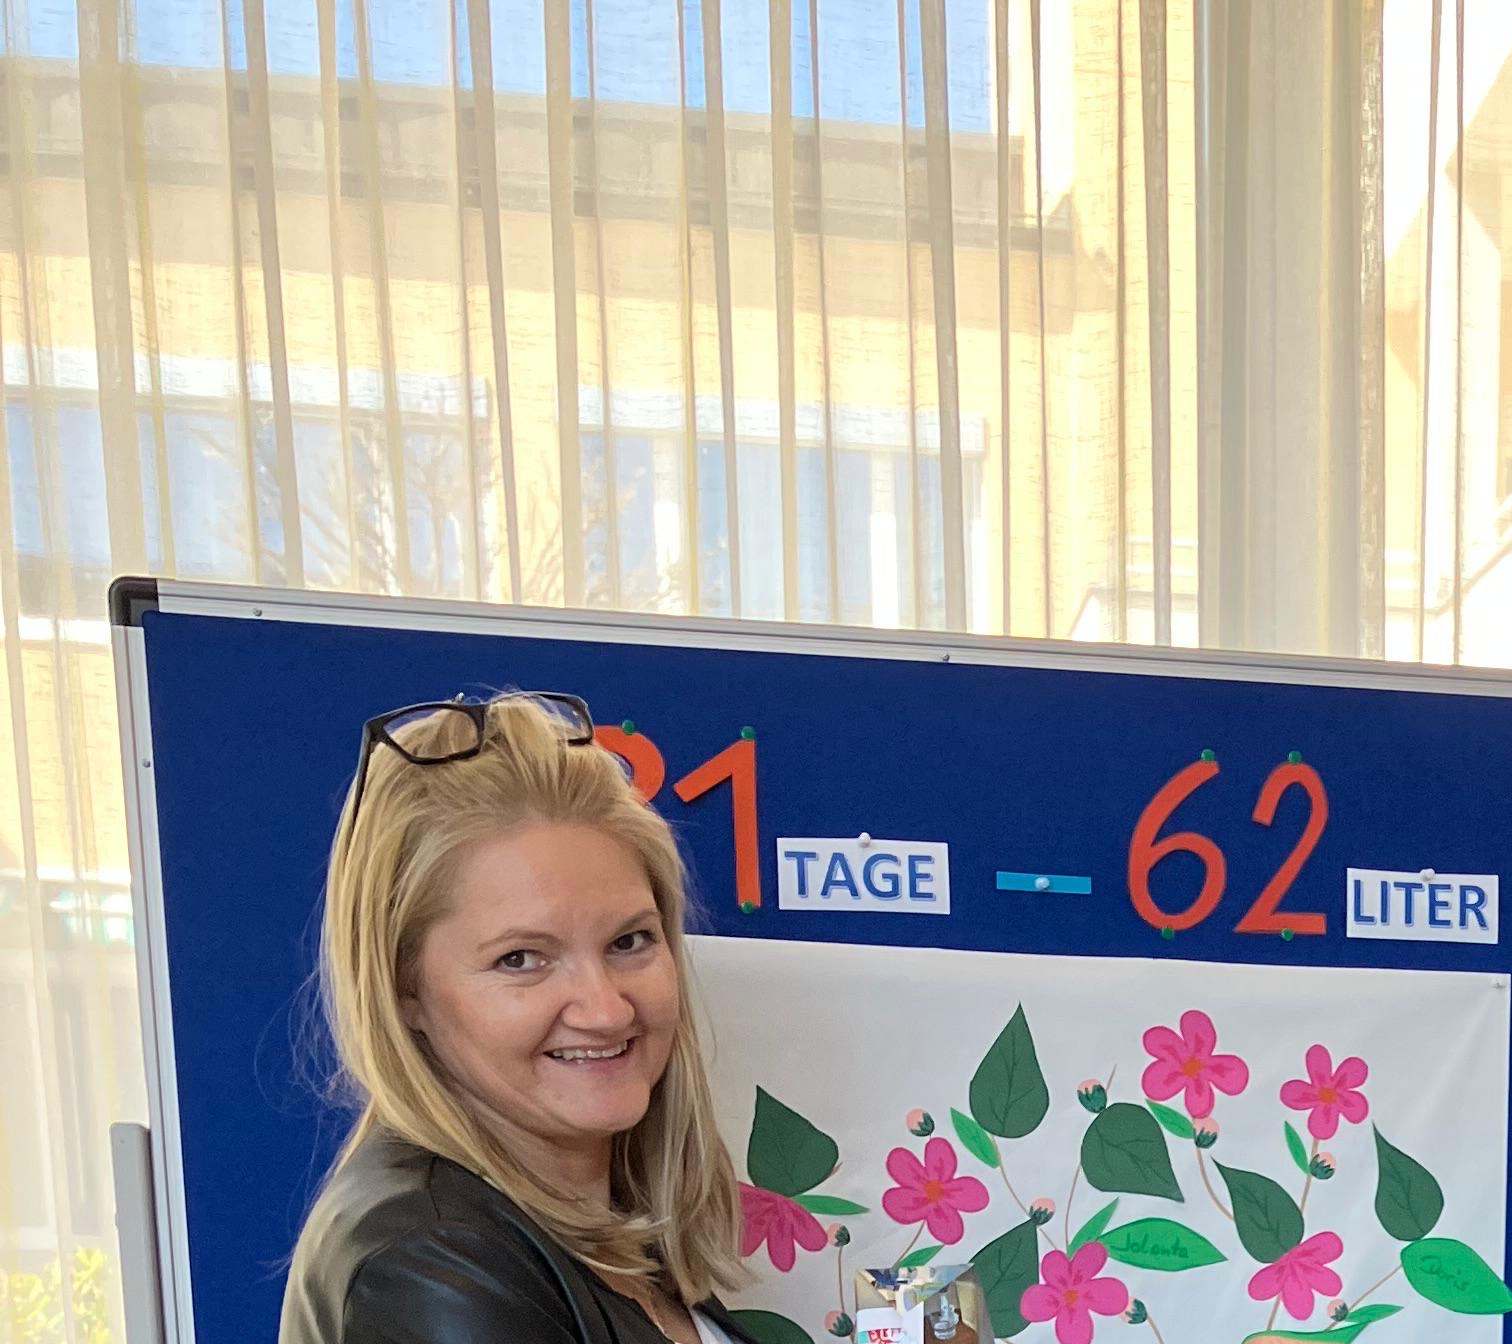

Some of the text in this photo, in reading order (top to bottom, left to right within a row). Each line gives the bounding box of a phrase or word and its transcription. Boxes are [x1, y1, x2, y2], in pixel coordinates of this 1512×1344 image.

[784, 851, 937, 902] TAGE
[1127, 759, 1329, 936] 62
[1353, 879, 1488, 930] LITER
